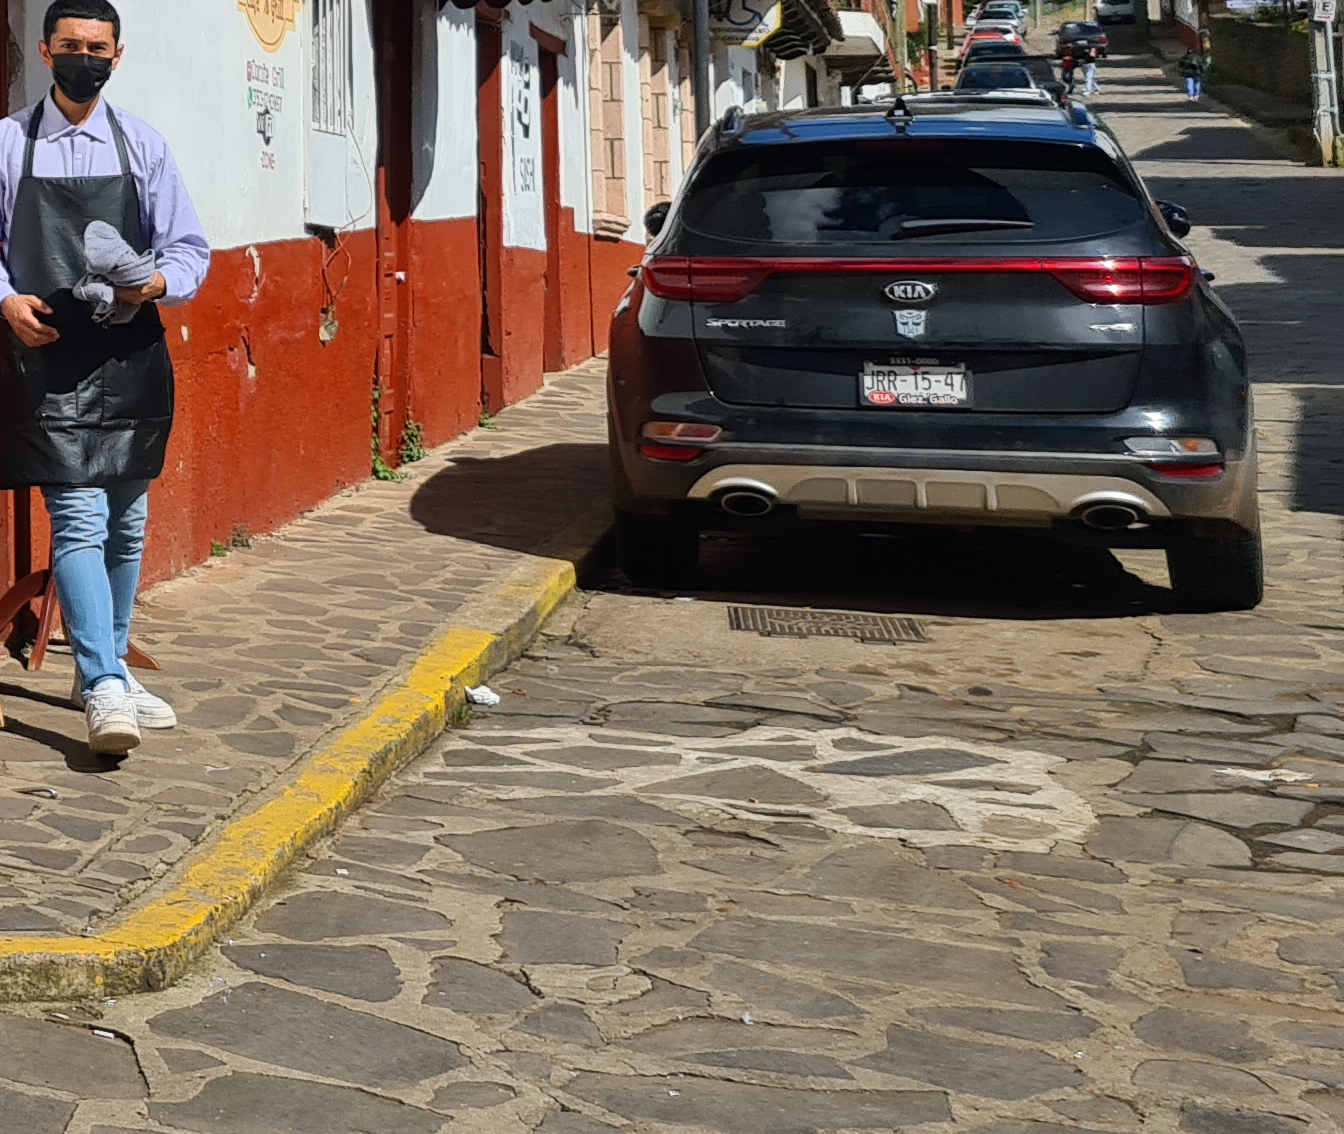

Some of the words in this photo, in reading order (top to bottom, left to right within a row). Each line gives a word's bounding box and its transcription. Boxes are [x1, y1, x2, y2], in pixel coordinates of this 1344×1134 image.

[892, 284, 927, 299] KIA
[705, 317, 786, 329] SPORTAGE
[865, 369, 967, 392] JRR-15-47
[871, 392, 893, 402] KIA
